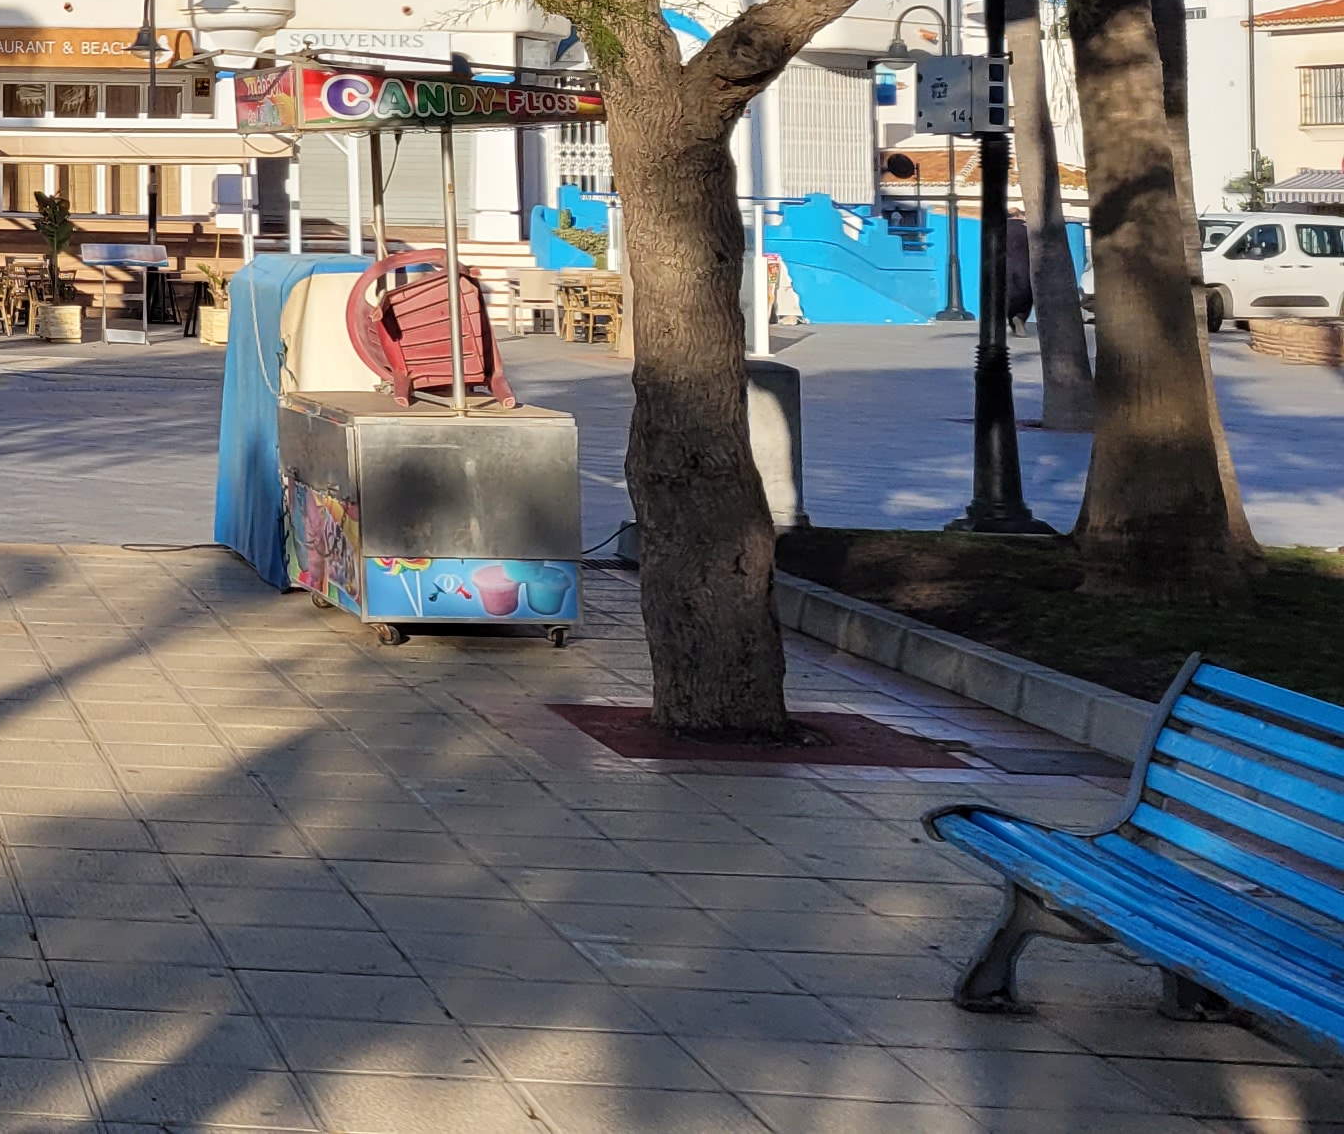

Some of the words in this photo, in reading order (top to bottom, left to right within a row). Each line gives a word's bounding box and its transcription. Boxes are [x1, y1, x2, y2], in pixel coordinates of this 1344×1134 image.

[289, 33, 425, 48] SOUVENIRS
[62, 41, 74, 55] &
[81, 41, 132, 55] BEACH
[321, 74, 496, 120] CANDY
[505, 89, 580, 114] FLOSS
[951, 109, 966, 123] 14
